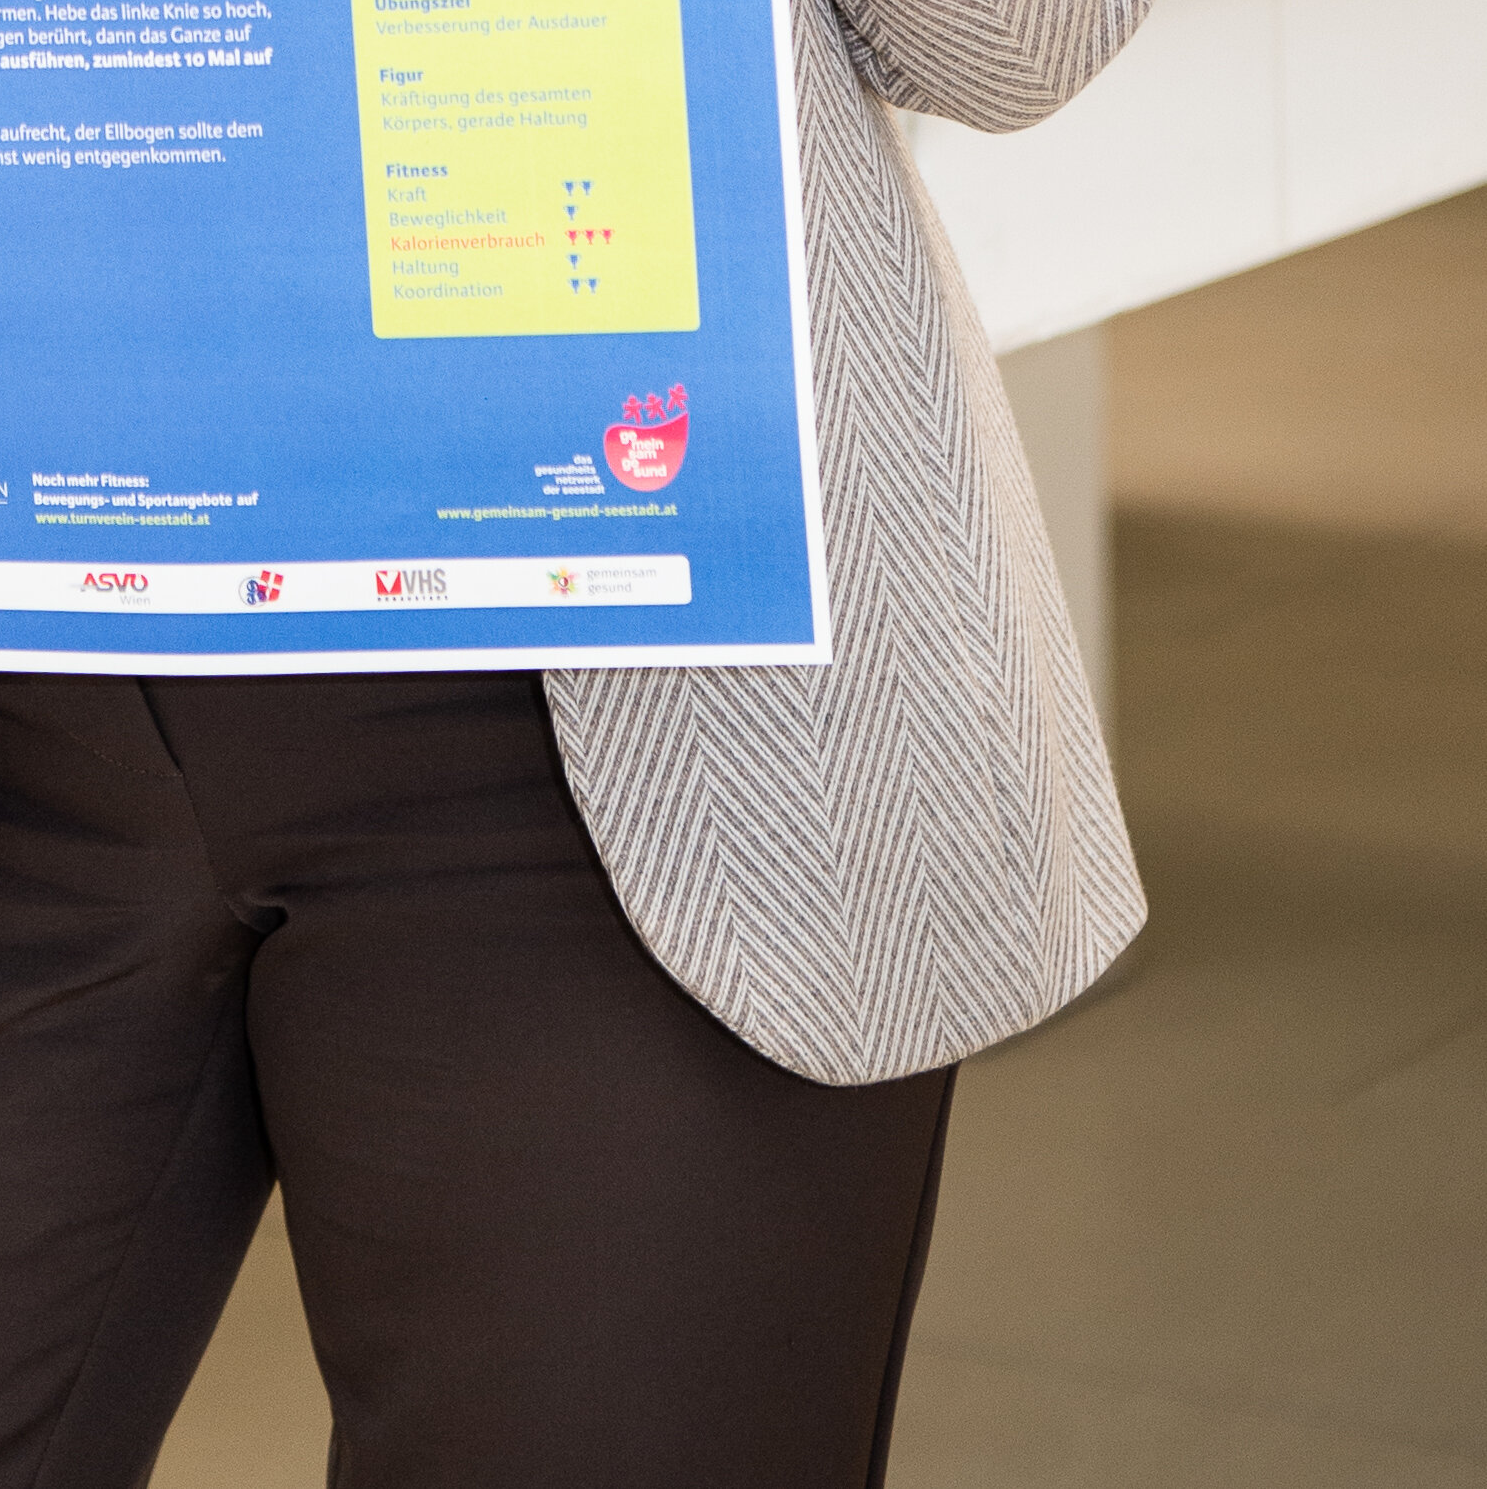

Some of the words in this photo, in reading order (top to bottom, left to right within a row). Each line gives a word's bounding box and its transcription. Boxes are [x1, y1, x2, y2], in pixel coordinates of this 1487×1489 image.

[44, 3, 87, 21] Hebe
[90, 3, 118, 21] das
[120, 2, 160, 20] linke
[163, 2, 200, 20] Knie
[202, 5, 222, 20] so
[225, 0, 272, 19] hoch,
[27, 27, 92, 46] berührt,
[95, 27, 136, 45] dann
[139, 26, 168, 44] das
[170, 25, 221, 44] Ganze
[224, 24, 252, 42] auf
[375, 18, 491, 36] Verbesserung
[495, 15, 522, 32] der
[528, 14, 607, 30] Ausdauer
[0, 50, 90, 71] ausführen,
[92, 49, 182, 68] zumindest
[183, 51, 206, 67] 10
[207, 47, 241, 67] Mal
[243, 47, 274, 66] auf
[379, 68, 423, 86] Figur
[380, 90, 470, 110] Kräftigung
[474, 88, 504, 104] des
[508, 87, 592, 107] gesamten
[382, 116, 453, 133] Körpers,
[457, 112, 515, 133] gerade
[519, 110, 588, 128] Haltung
[0, 123, 71, 143] aufrecht,
[74, 123, 101, 141] der
[104, 122, 175, 144] Ellbogen
[178, 121, 223, 140] sollte
[226, 120, 263, 139] dem
[21, 147, 71, 169] wenig
[74, 146, 226, 169] entgegenkommen.
[385, 163, 448, 178] Fitness
[387, 186, 426, 202] Kraft
[388, 208, 506, 229] Beweglichkeit
[390, 232, 545, 251] Kalorienverbrauch
[392, 259, 459, 278] Haltung
[393, 283, 503, 300] Koordination
[32, 472, 66, 487] Noch
[66, 473, 100, 487] mehr
[100, 473, 150, 488] Fitness:
[33, 491, 110, 509] Bewegungs-
[111, 492, 136, 507] und
[137, 492, 233, 510] Sportangebote
[236, 491, 259, 506] auf
[35, 512, 211, 526] www.turnverein-seestadt.at
[436, 502, 678, 522] www.gemeinsam-gesund-seestadt.at
[402, 568, 447, 594] VHS
[120, 595, 151, 606] Wien
